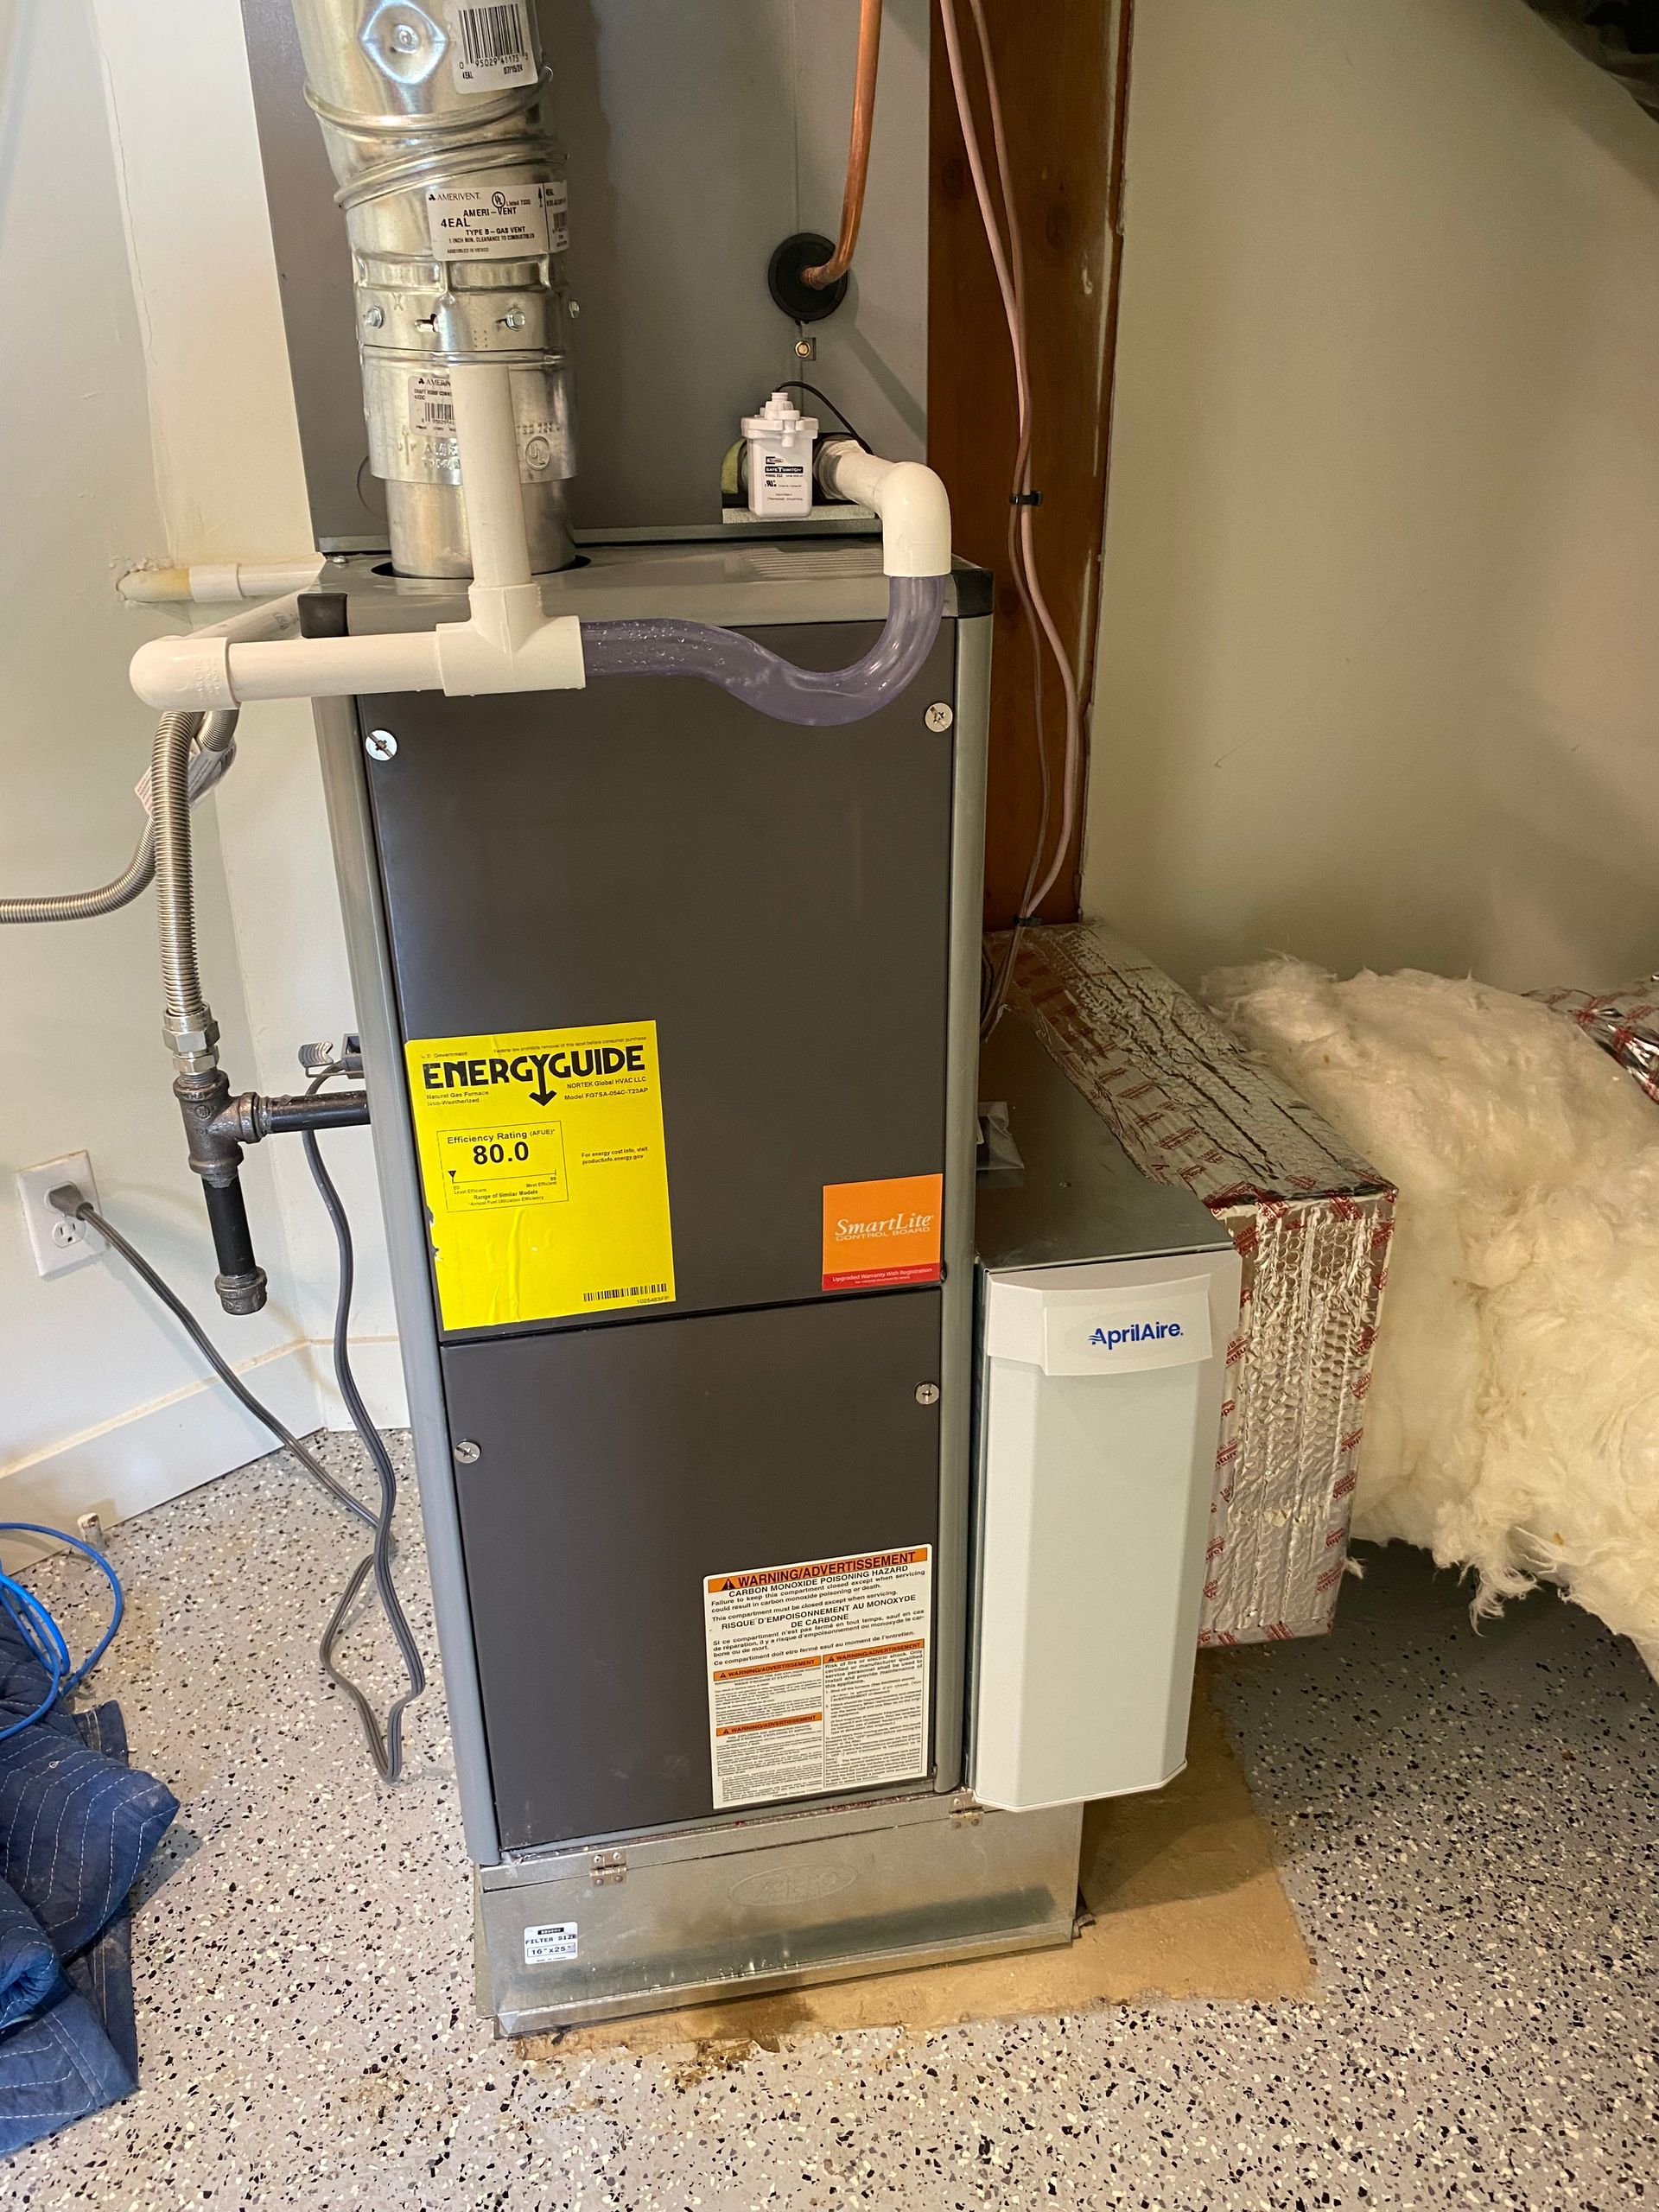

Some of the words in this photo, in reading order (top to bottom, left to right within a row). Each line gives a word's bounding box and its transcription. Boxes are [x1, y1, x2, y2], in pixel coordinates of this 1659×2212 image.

[475, 57, 497, 67] 95029
[501, 54, 519, 64] 41175
[441, 218, 470, 228] 4EAL
[423, 1045, 645, 1090] ENERGYGUIDE
[447, 1135, 493, 1144] Efficiency
[473, 1141, 529, 1165] 80.0
[836, 1212, 933, 1237] SmartLite
[836, 1232, 889, 1241] CONTROL
[892, 1227, 930, 1236] BOARD
[832, 1274, 860, 1282] Upgraded
[737, 1551, 916, 1587] WARNING/ADVERTISSEMENT
[729, 1586, 768, 1598] CARBON
[770, 1579, 817, 1592] MONOXIDE
[821, 1571, 869, 1584] POISONING
[872, 1565, 908, 1576] HAZARD
[780, 1585, 824, 1597] compartment
[851, 1578, 873, 1586] except
[895, 1570, 925, 1579] servicing
[785, 1593, 817, 1603] monoxide
[819, 1588, 851, 1598] poisoning
[721, 1620, 755, 1630] RISQUE
[758, 1605, 849, 1624] D'EMPOISONNEMENT
[867, 1594, 916, 1608] MONOXYDE
[728, 1609, 772, 1620] compartment
[867, 1590, 898, 1599] servicing.
[805, 1614, 849, 1625] CARBONE
[870, 1618, 904, 1628] monoxyde
[733, 1631, 779, 1643] compartiment
[725, 1653, 770, 1664] compartiment
